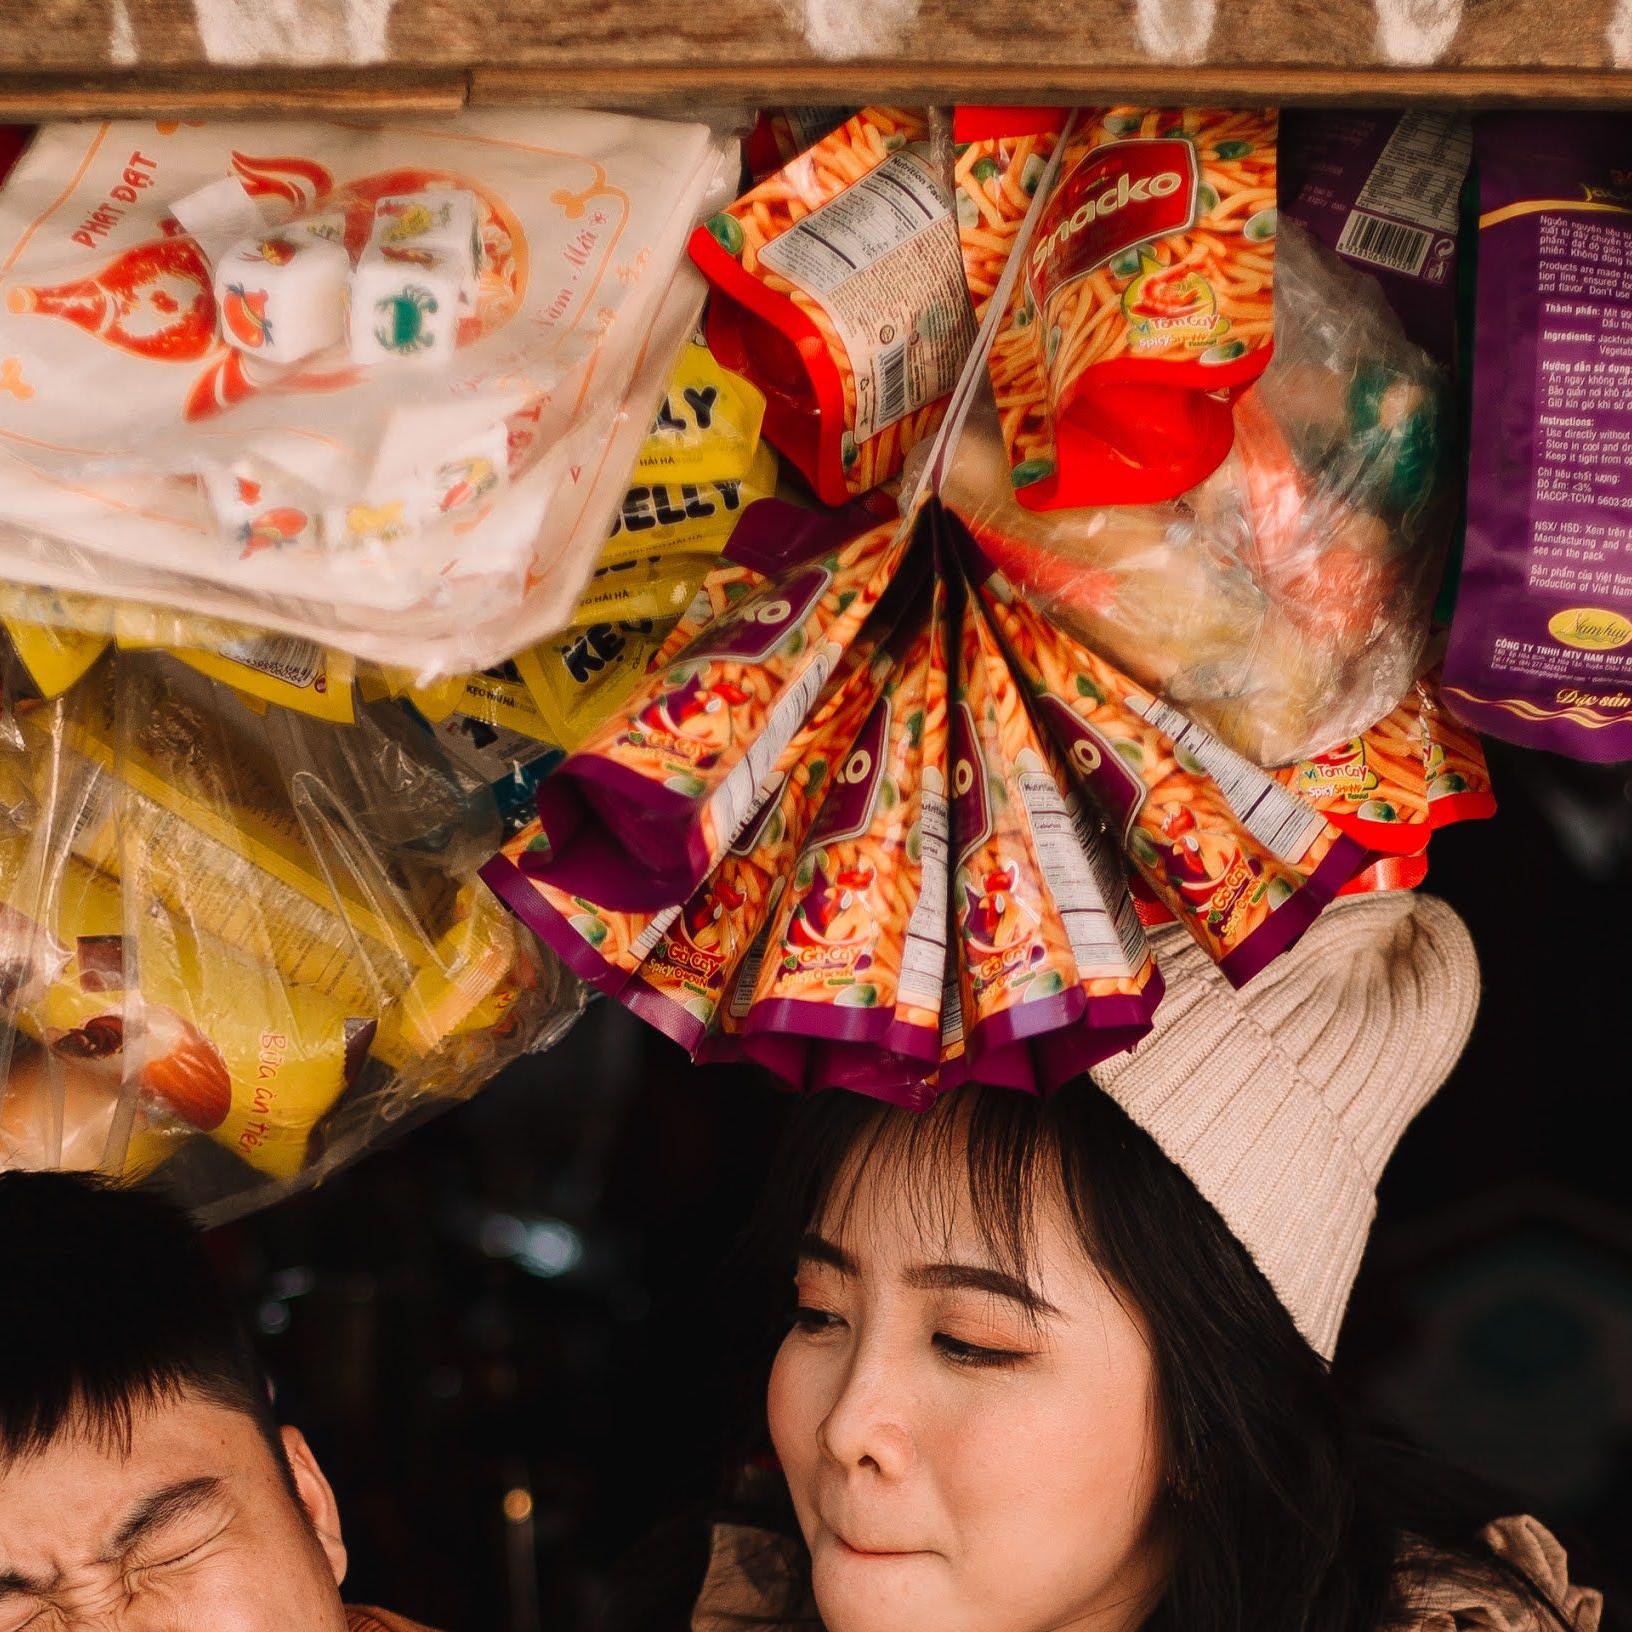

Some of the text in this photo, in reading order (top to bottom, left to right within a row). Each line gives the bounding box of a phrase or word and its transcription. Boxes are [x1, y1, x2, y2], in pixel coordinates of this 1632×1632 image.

[1544, 330, 1632, 346] Ingredients: Jackfruit
[1540, 415, 1595, 427] Instructions:
[1565, 429, 1597, 441] directly
[1600, 431, 1631, 441] without
[1546, 439, 1568, 449] Store
[1583, 441, 1600, 451] cool
[1603, 442, 1619, 451] and
[1545, 450, 1567, 462] Keep
[1579, 452, 1599, 464] tight
[1601, 452, 1621, 463] from
[1602, 538, 1619, 551] and
[1529, 576, 1632, 597] Production of Nam
[1583, 653, 1604, 663] NAM
[1345, 765, 1367, 782] Cay
